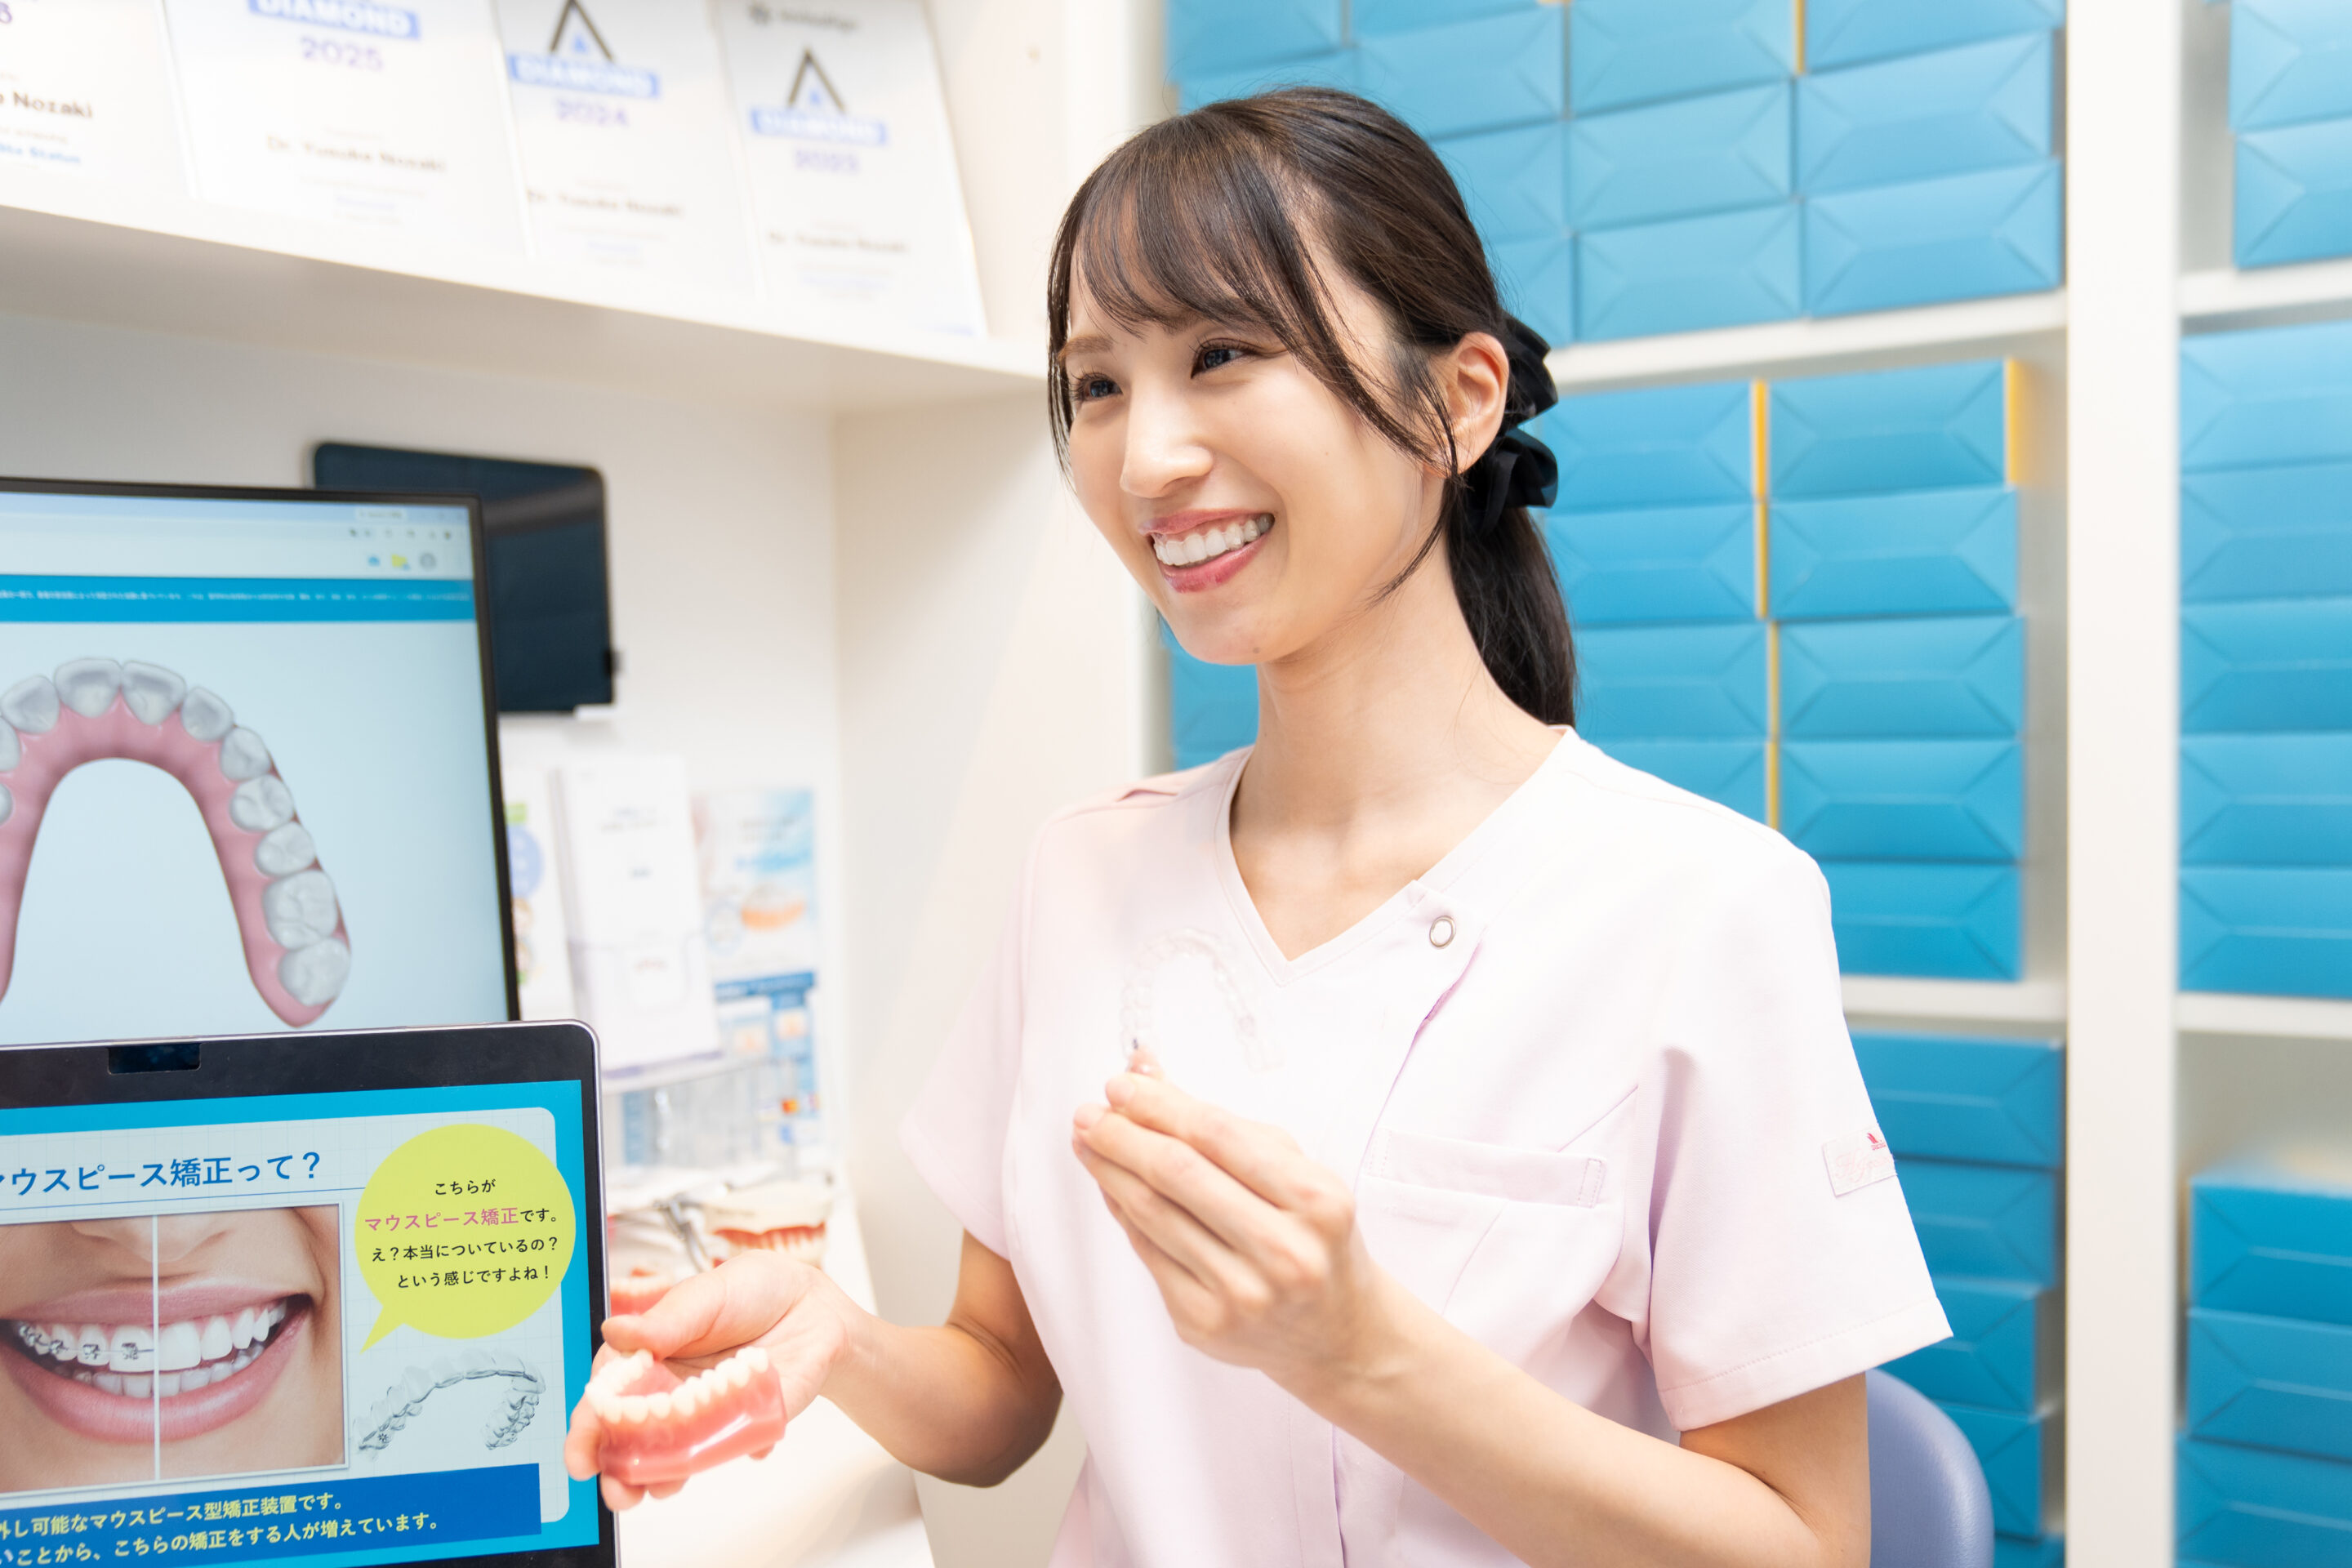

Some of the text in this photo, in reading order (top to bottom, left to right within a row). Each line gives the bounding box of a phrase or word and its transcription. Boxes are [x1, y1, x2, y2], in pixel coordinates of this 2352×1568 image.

[299, 36, 384, 72] 2025
[12, 91, 93, 119] Nozaki
[0, 1152, 321, 1196] ウスピース矯正って？
[434, 1178, 497, 1196] こちらが
[365, 1207, 557, 1232] マウスピース矯正です。
[372, 1236, 558, 1262] え？本当についているの？
[398, 1265, 549, 1289] という感じですよね！
